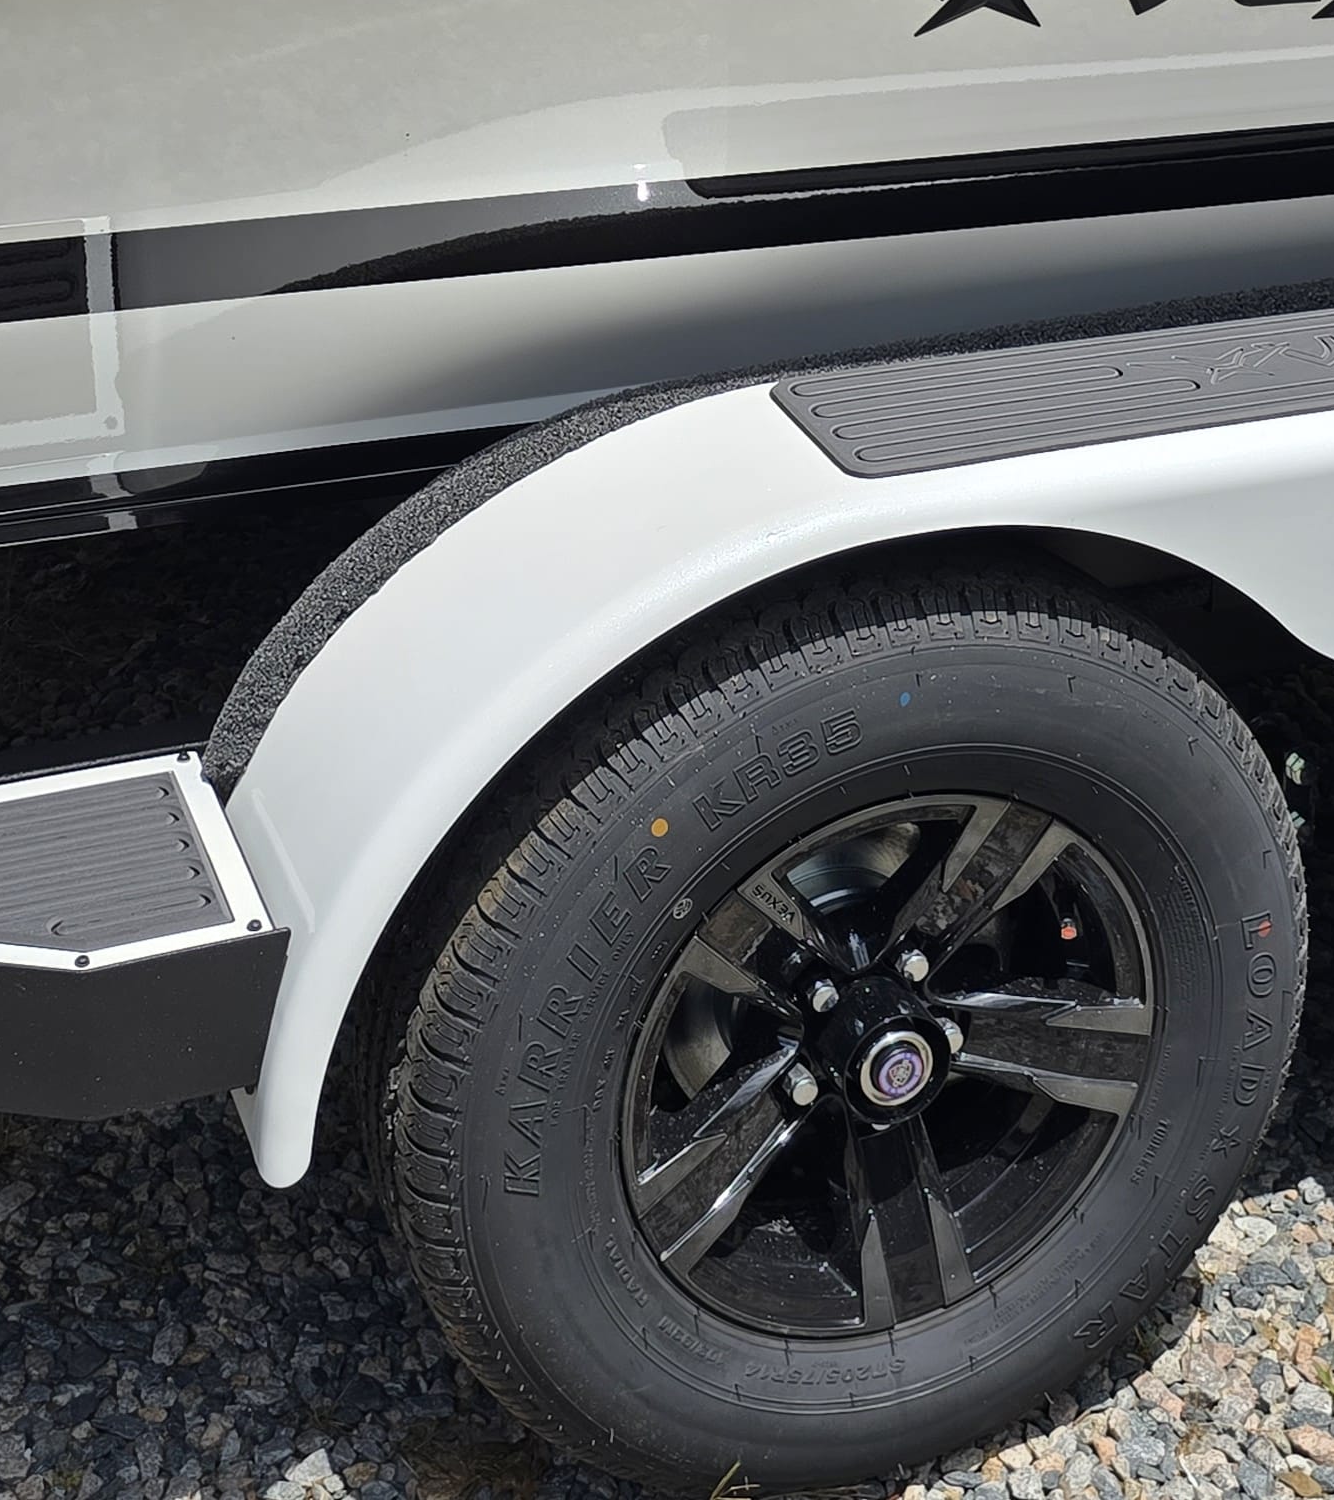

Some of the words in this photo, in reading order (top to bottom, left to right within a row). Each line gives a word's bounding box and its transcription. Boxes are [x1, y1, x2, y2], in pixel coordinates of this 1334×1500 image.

[503, 844, 672, 1198] KARRIER
[692, 707, 864, 832] KR35
[750, 884, 797, 925] VEXUS
[1232, 910, 1278, 1107] LOAD
[604, 1233, 651, 1309] RADIAL
[1073, 1173, 1216, 1349] STAR
